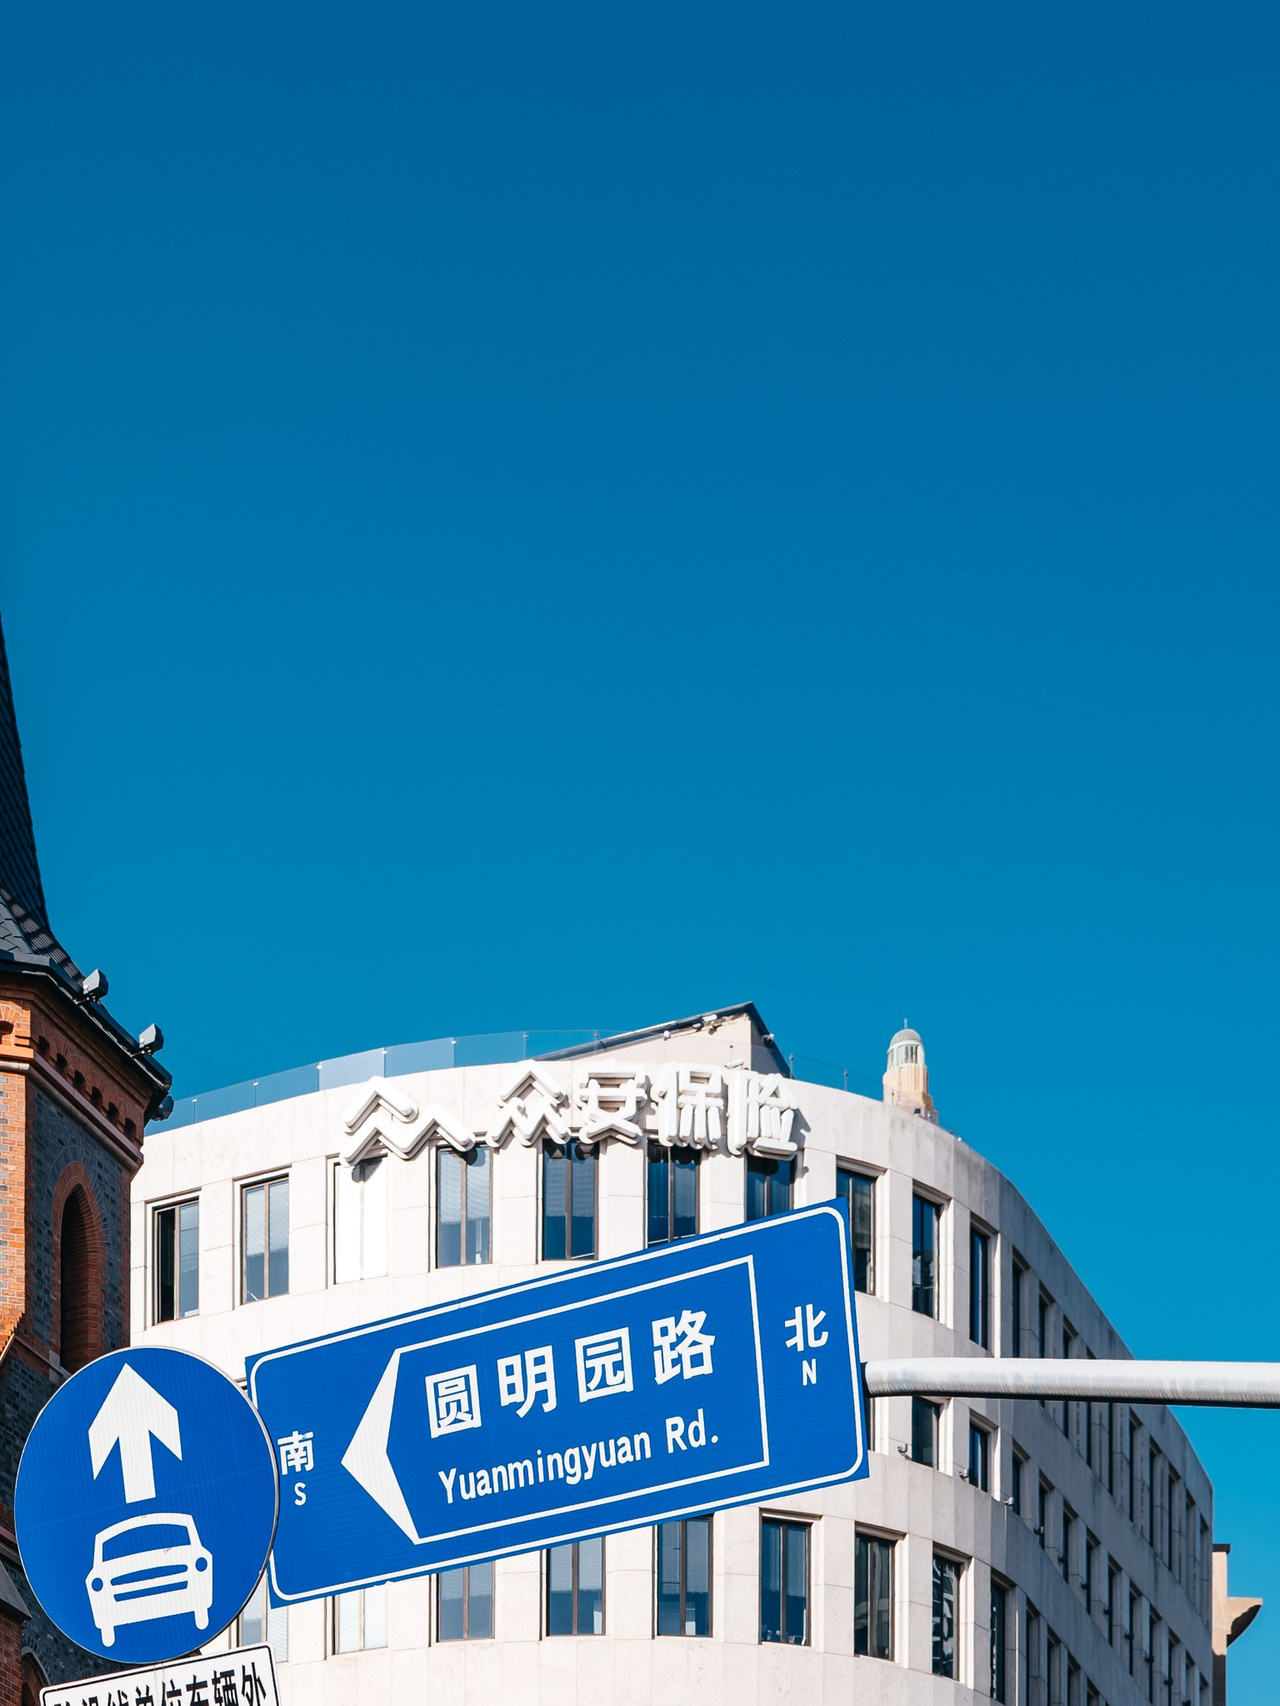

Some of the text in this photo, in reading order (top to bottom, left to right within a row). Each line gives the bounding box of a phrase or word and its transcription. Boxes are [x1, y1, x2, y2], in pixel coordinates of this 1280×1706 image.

[486, 1058, 800, 1161] 众安保险
[784, 1304, 829, 1353] 北
[425, 1309, 716, 1438] 圆明园路
[801, 1359, 817, 1387] N
[277, 1430, 314, 1476] 南
[438, 1409, 719, 1504] Yuanmingyuan Rd.
[294, 1482, 307, 1506] S
